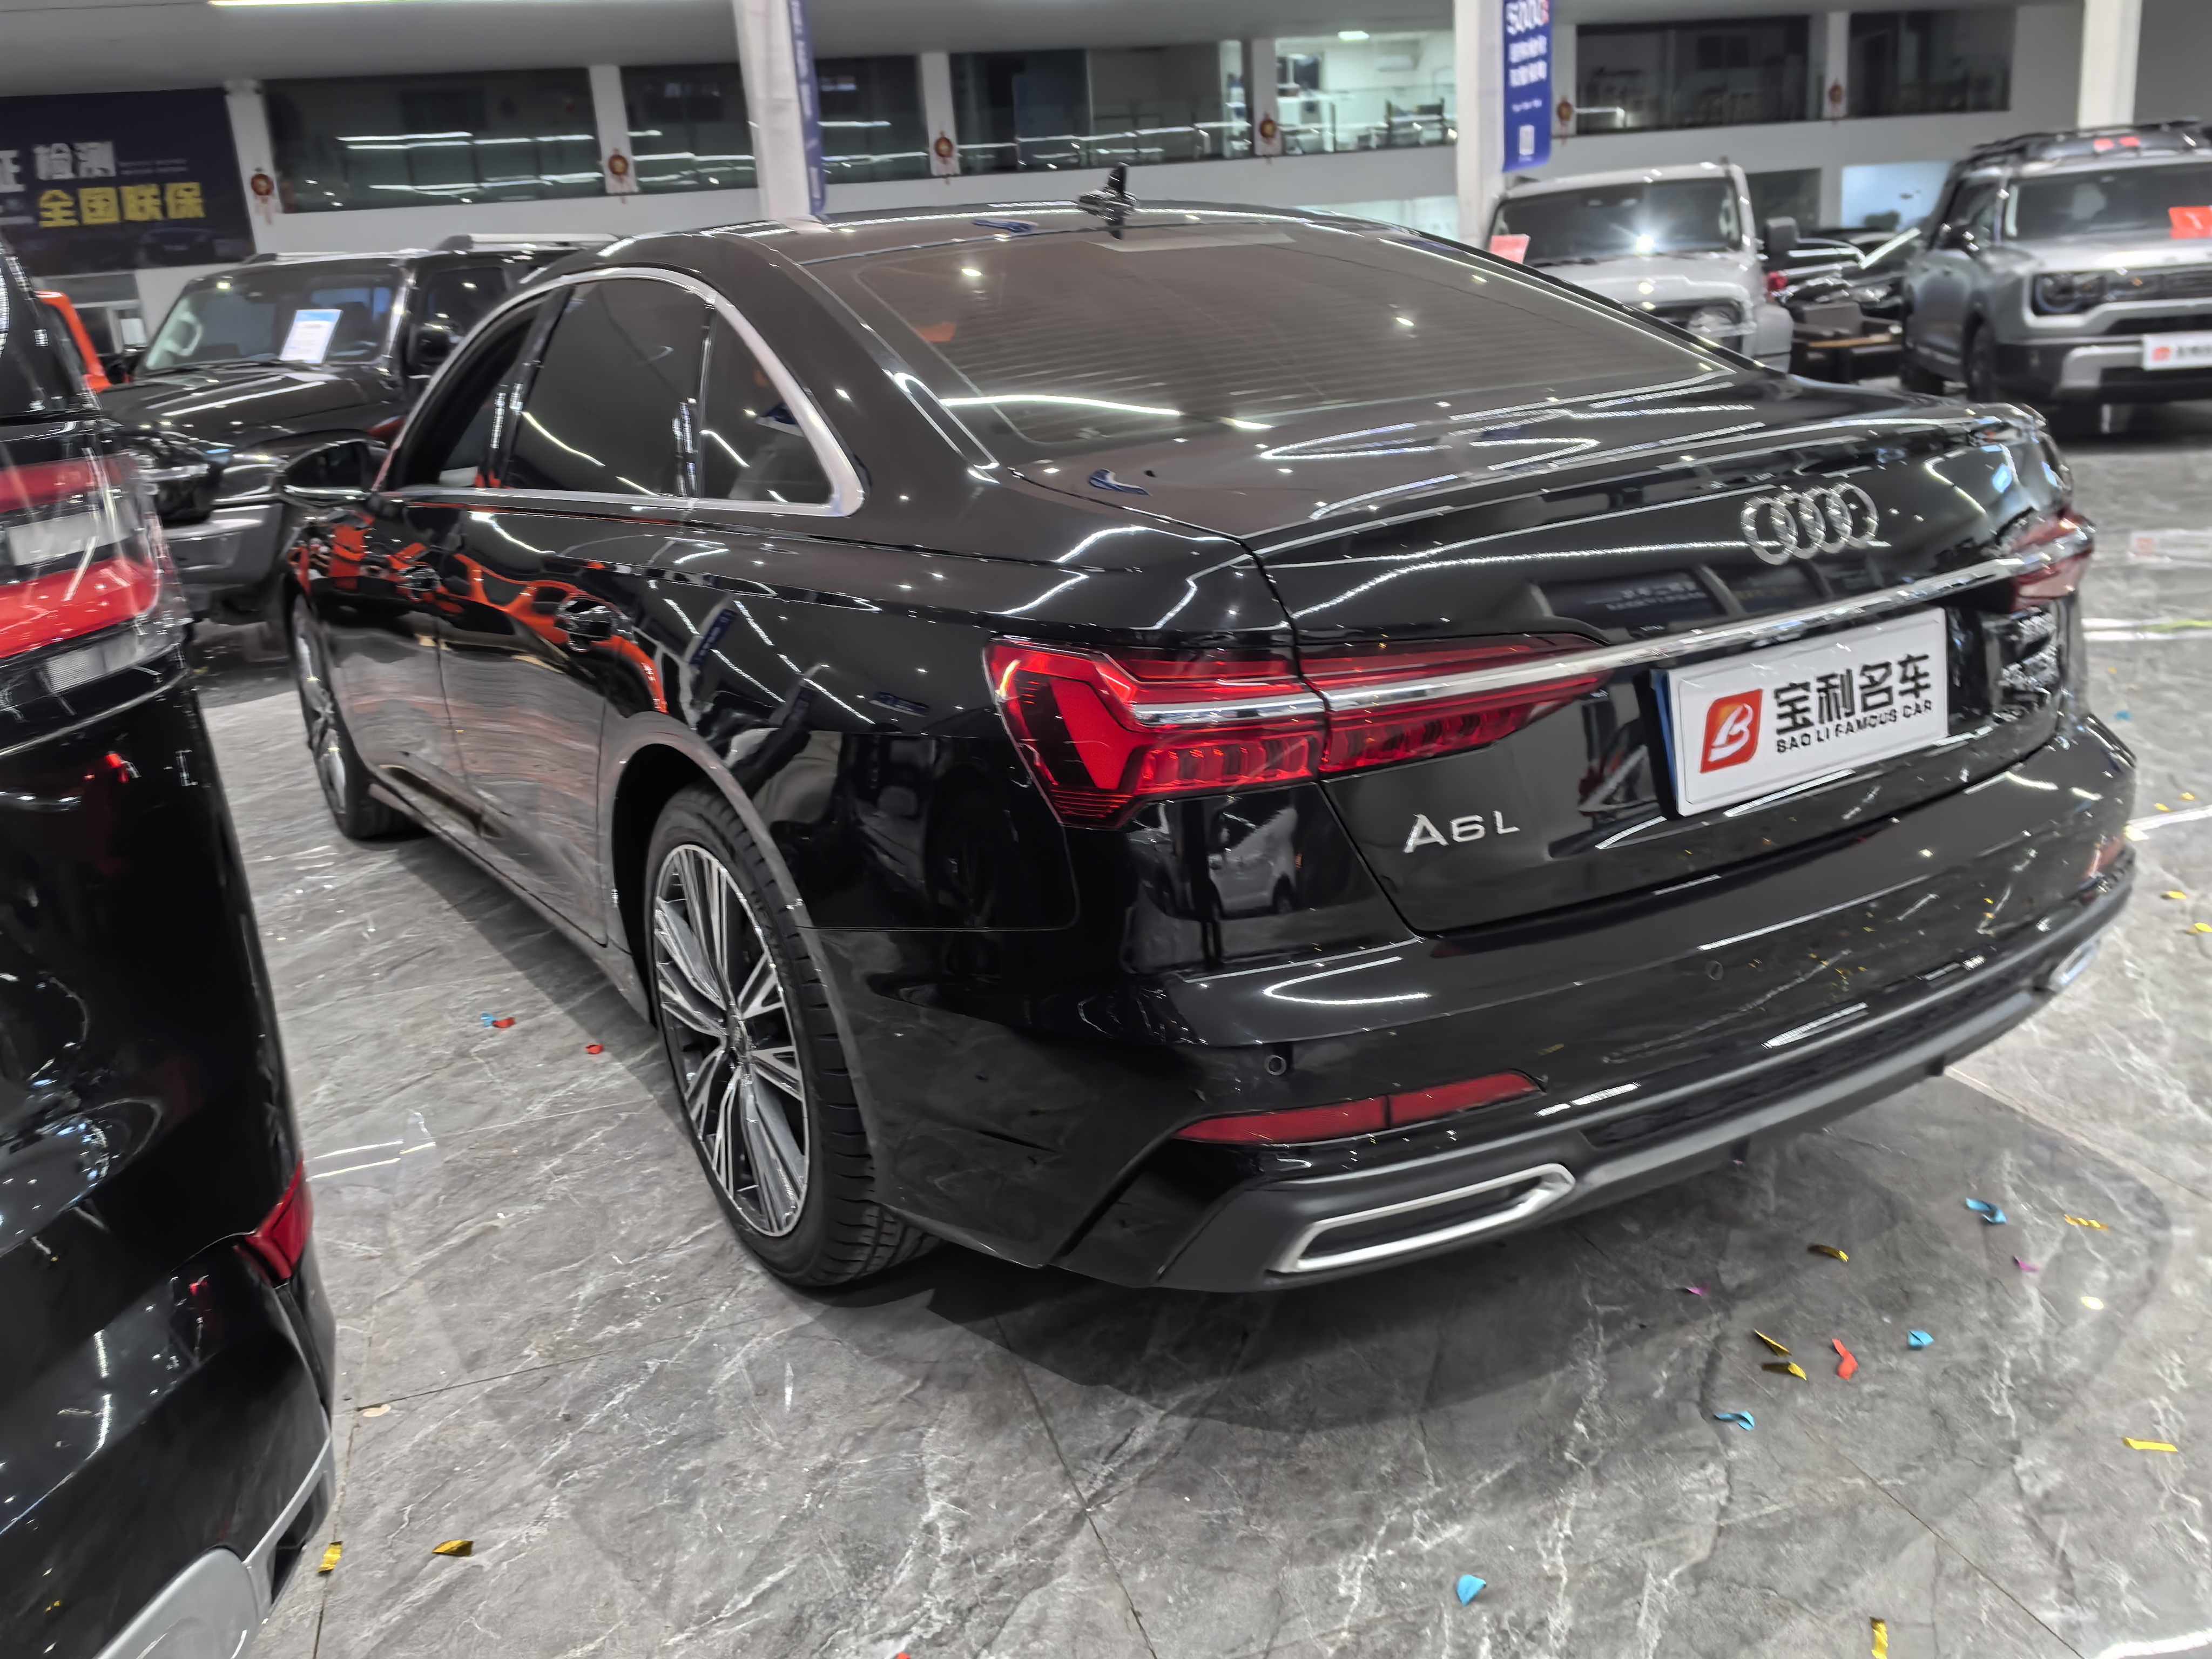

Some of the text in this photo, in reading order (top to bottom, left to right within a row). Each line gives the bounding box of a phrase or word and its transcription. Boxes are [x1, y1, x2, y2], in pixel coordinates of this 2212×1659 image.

[1773, 653, 1931, 735] 宝利名车
[1835, 709, 1898, 738] FAMOUS
[1902, 699, 1933, 718] CAR
